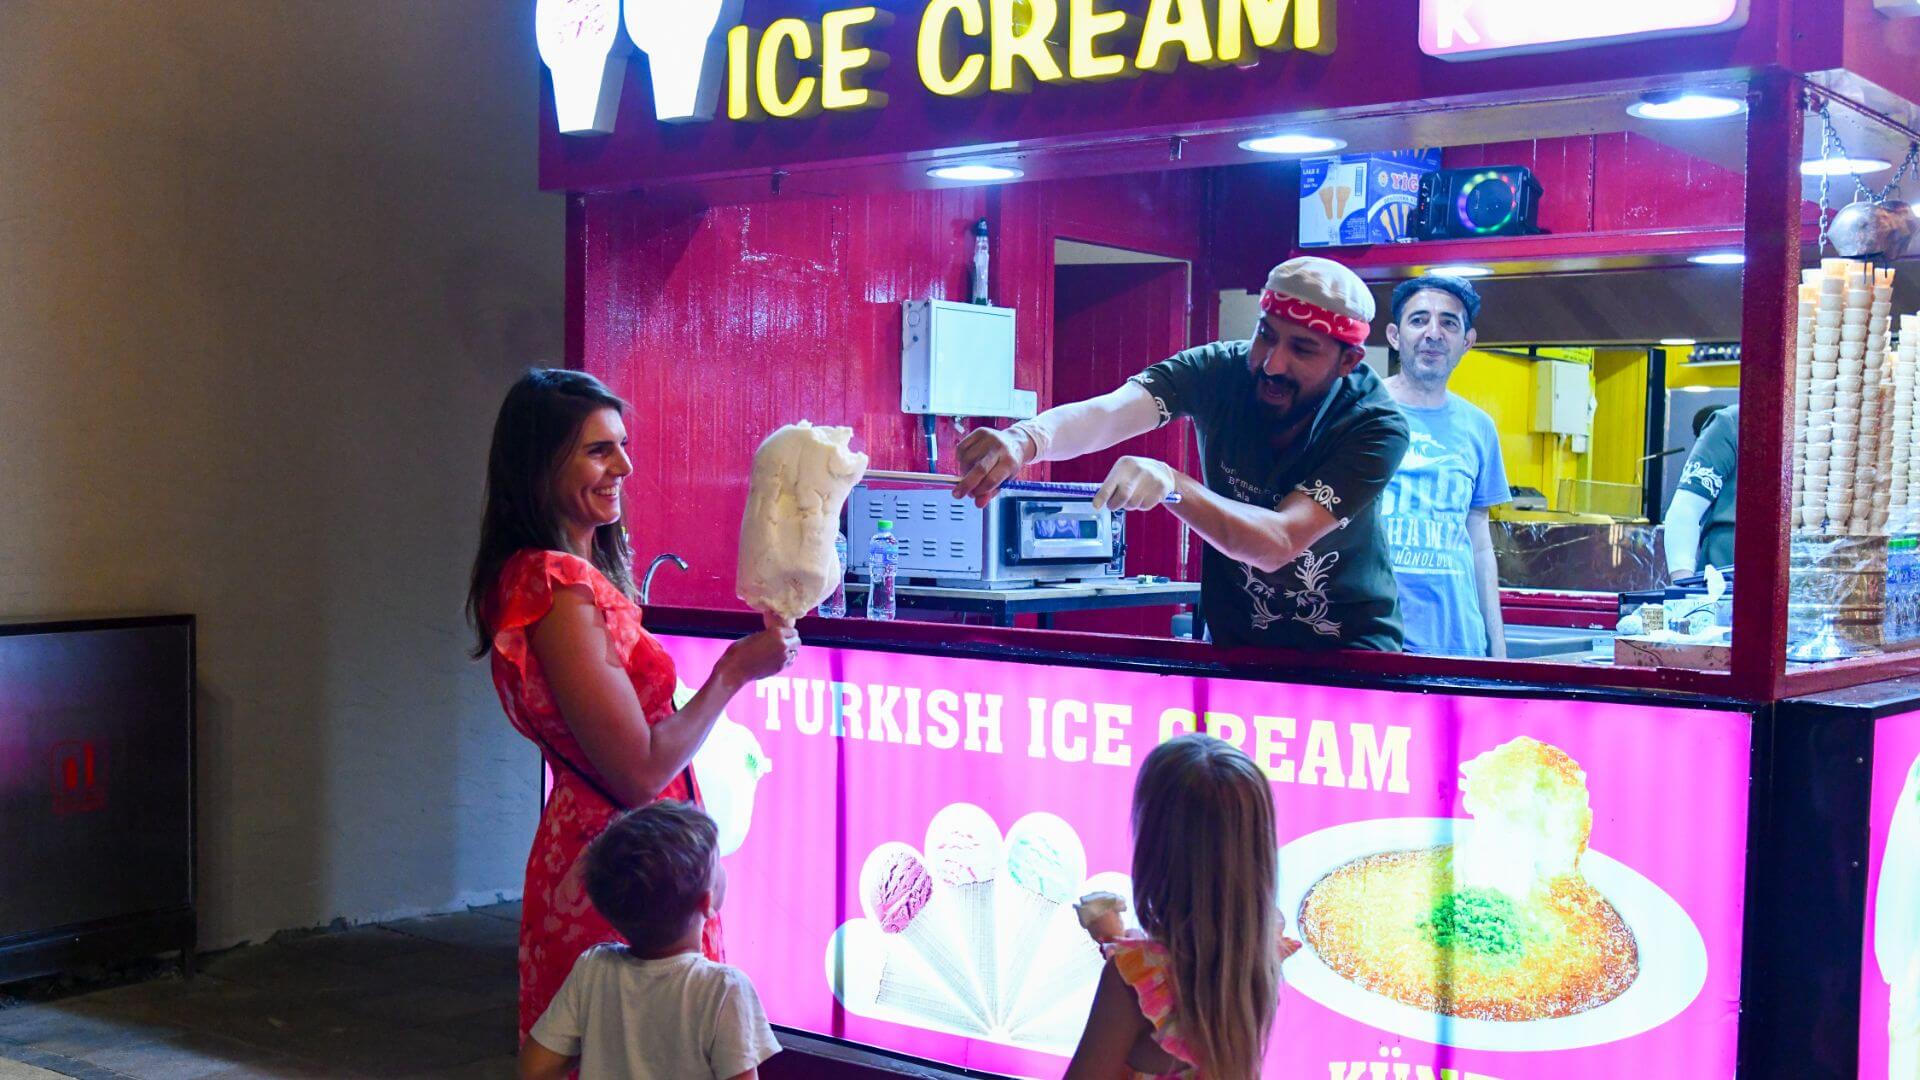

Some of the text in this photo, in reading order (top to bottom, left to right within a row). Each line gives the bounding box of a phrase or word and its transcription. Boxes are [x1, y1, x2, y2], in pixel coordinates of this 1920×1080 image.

[727, 0, 1320, 120] ICE CREAM
[756, 676, 1004, 754] TURKISH
[1027, 696, 1133, 767] ICE
